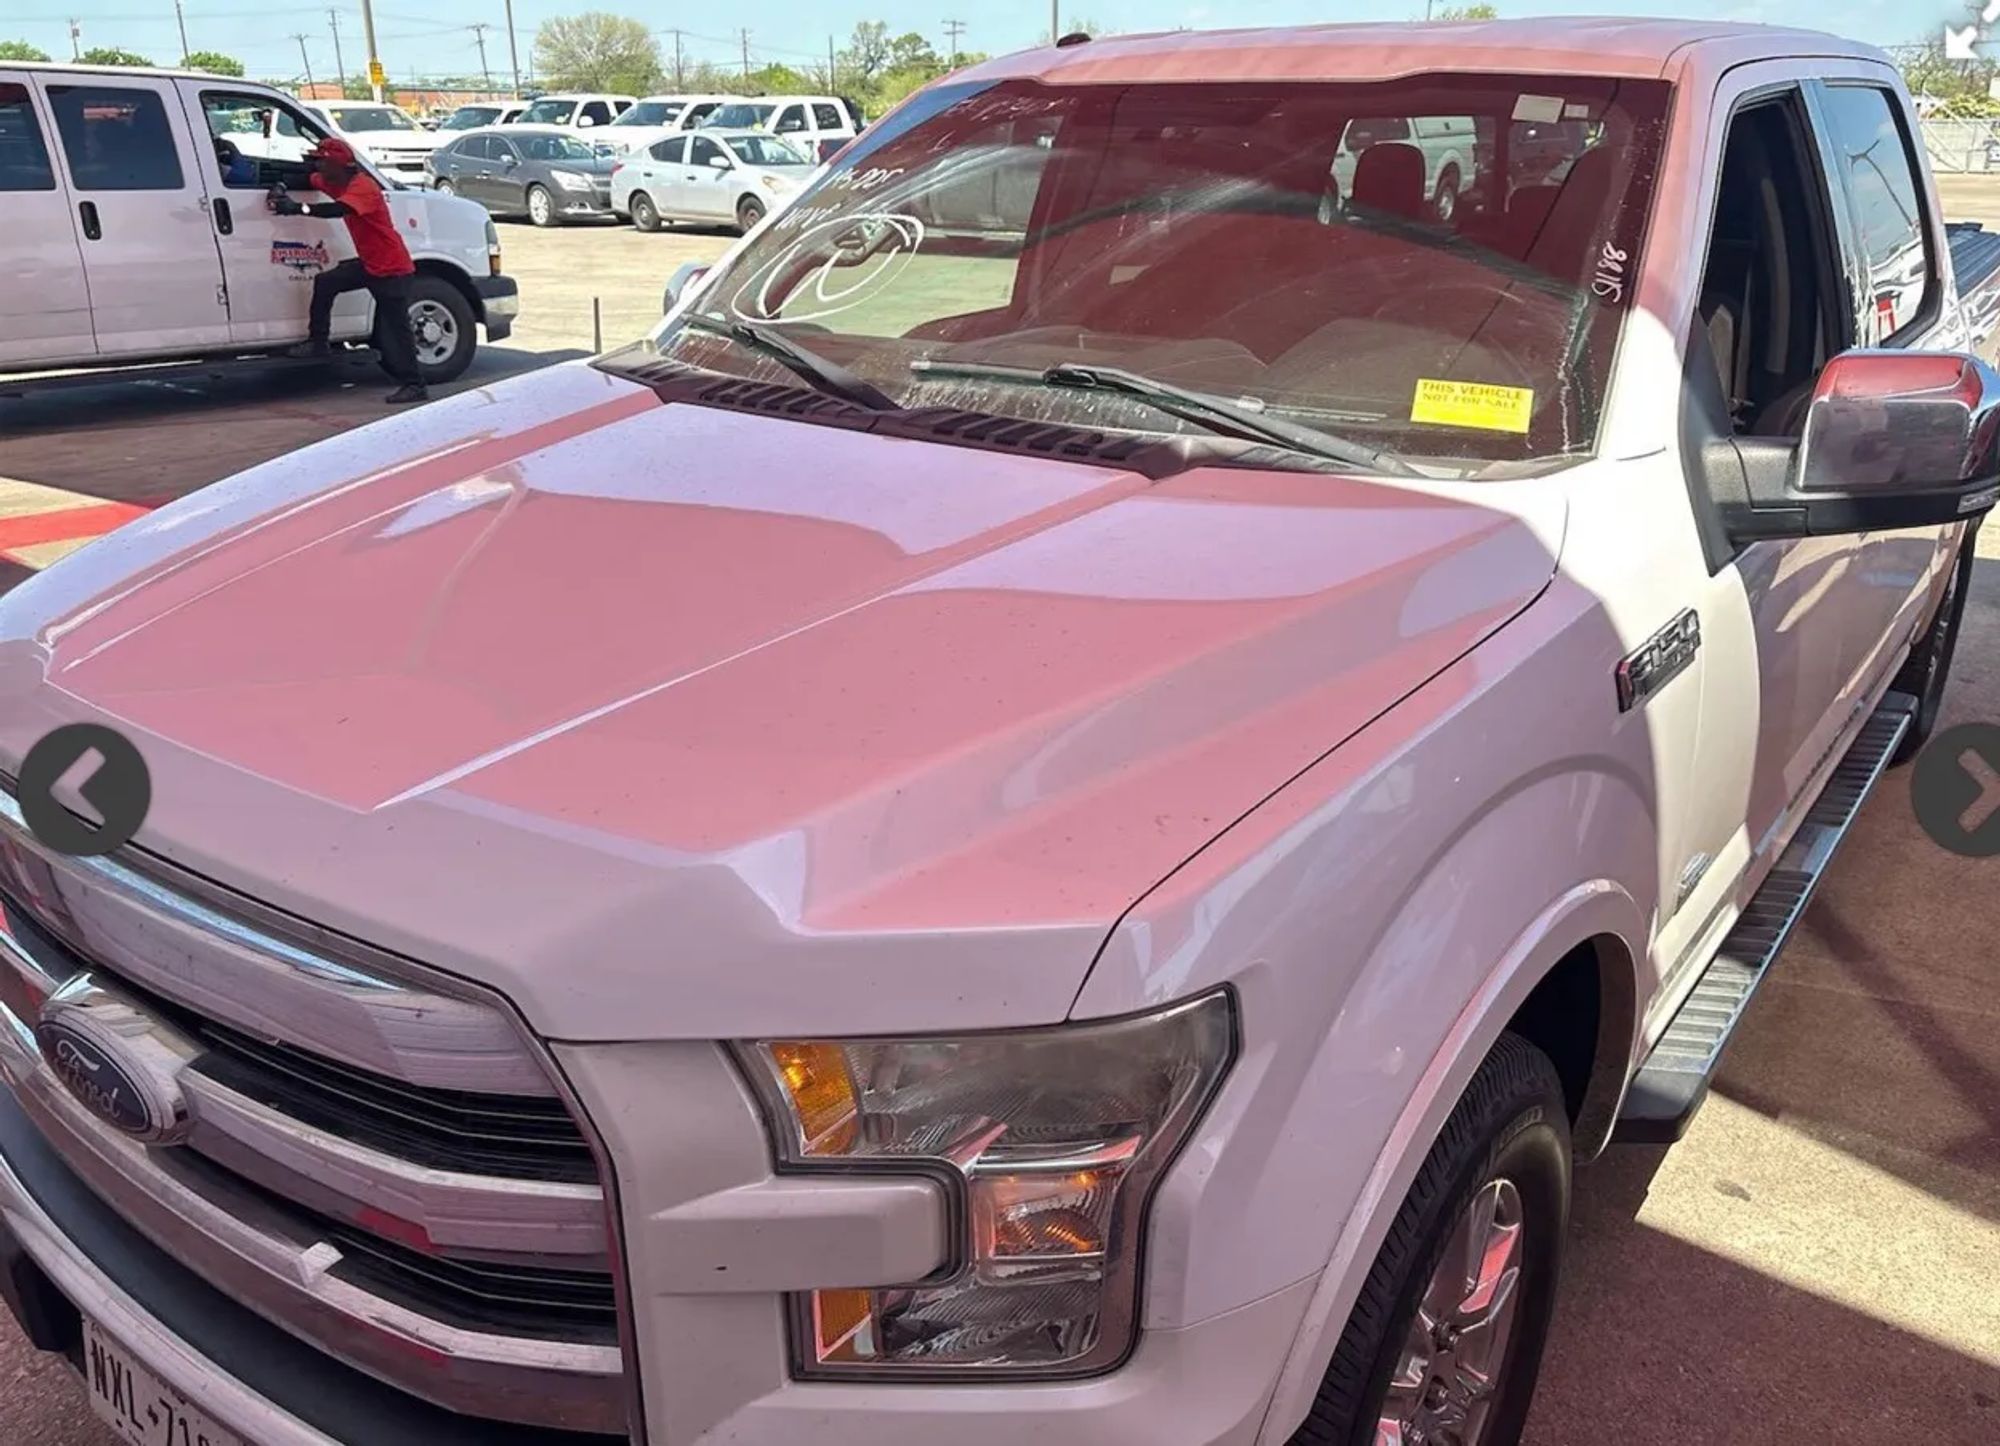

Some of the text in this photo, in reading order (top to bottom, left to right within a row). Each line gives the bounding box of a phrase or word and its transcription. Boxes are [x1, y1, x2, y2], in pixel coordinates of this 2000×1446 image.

[1422, 381, 1524, 401] THIS VEHICLE
[1422, 393, 1519, 410] NOT FOR SALE
[54, 1039, 121, 1118] Ford
